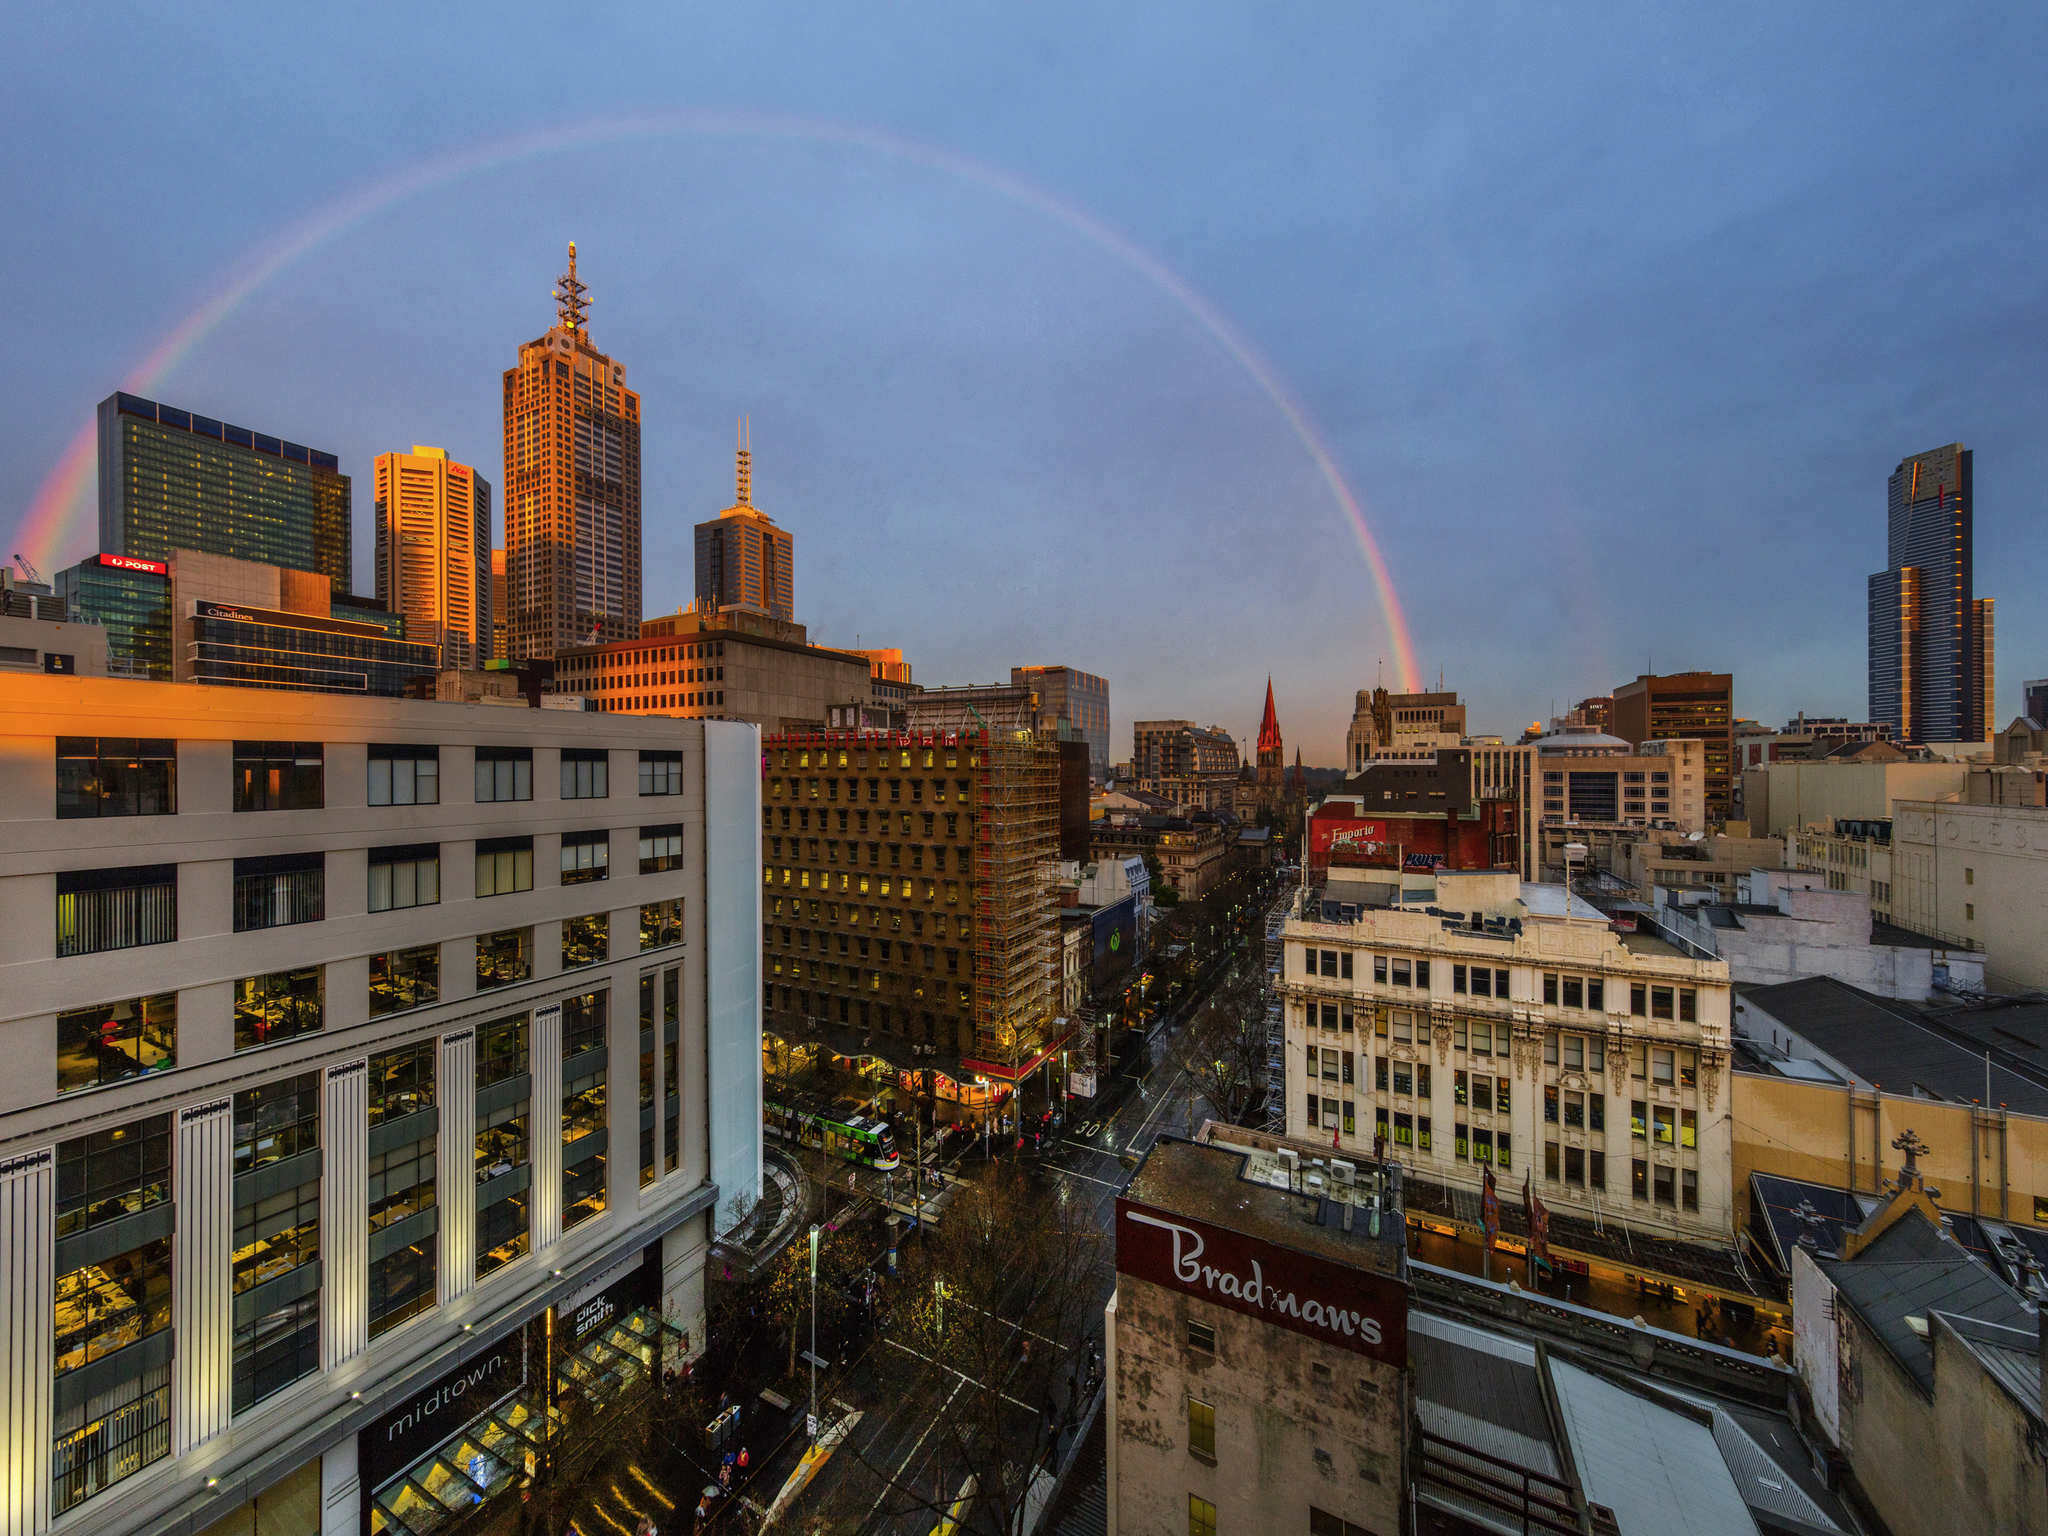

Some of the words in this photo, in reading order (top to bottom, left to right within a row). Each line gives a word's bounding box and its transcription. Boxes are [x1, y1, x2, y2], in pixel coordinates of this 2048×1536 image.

[125, 560, 156, 571] POST
[208, 608, 254, 621] Citadines
[1075, 1120, 1101, 1138] 30
[1126, 1210, 1383, 1345] Bradman's
[576, 1295, 606, 1323] dick
[576, 1303, 614, 1337] smith
